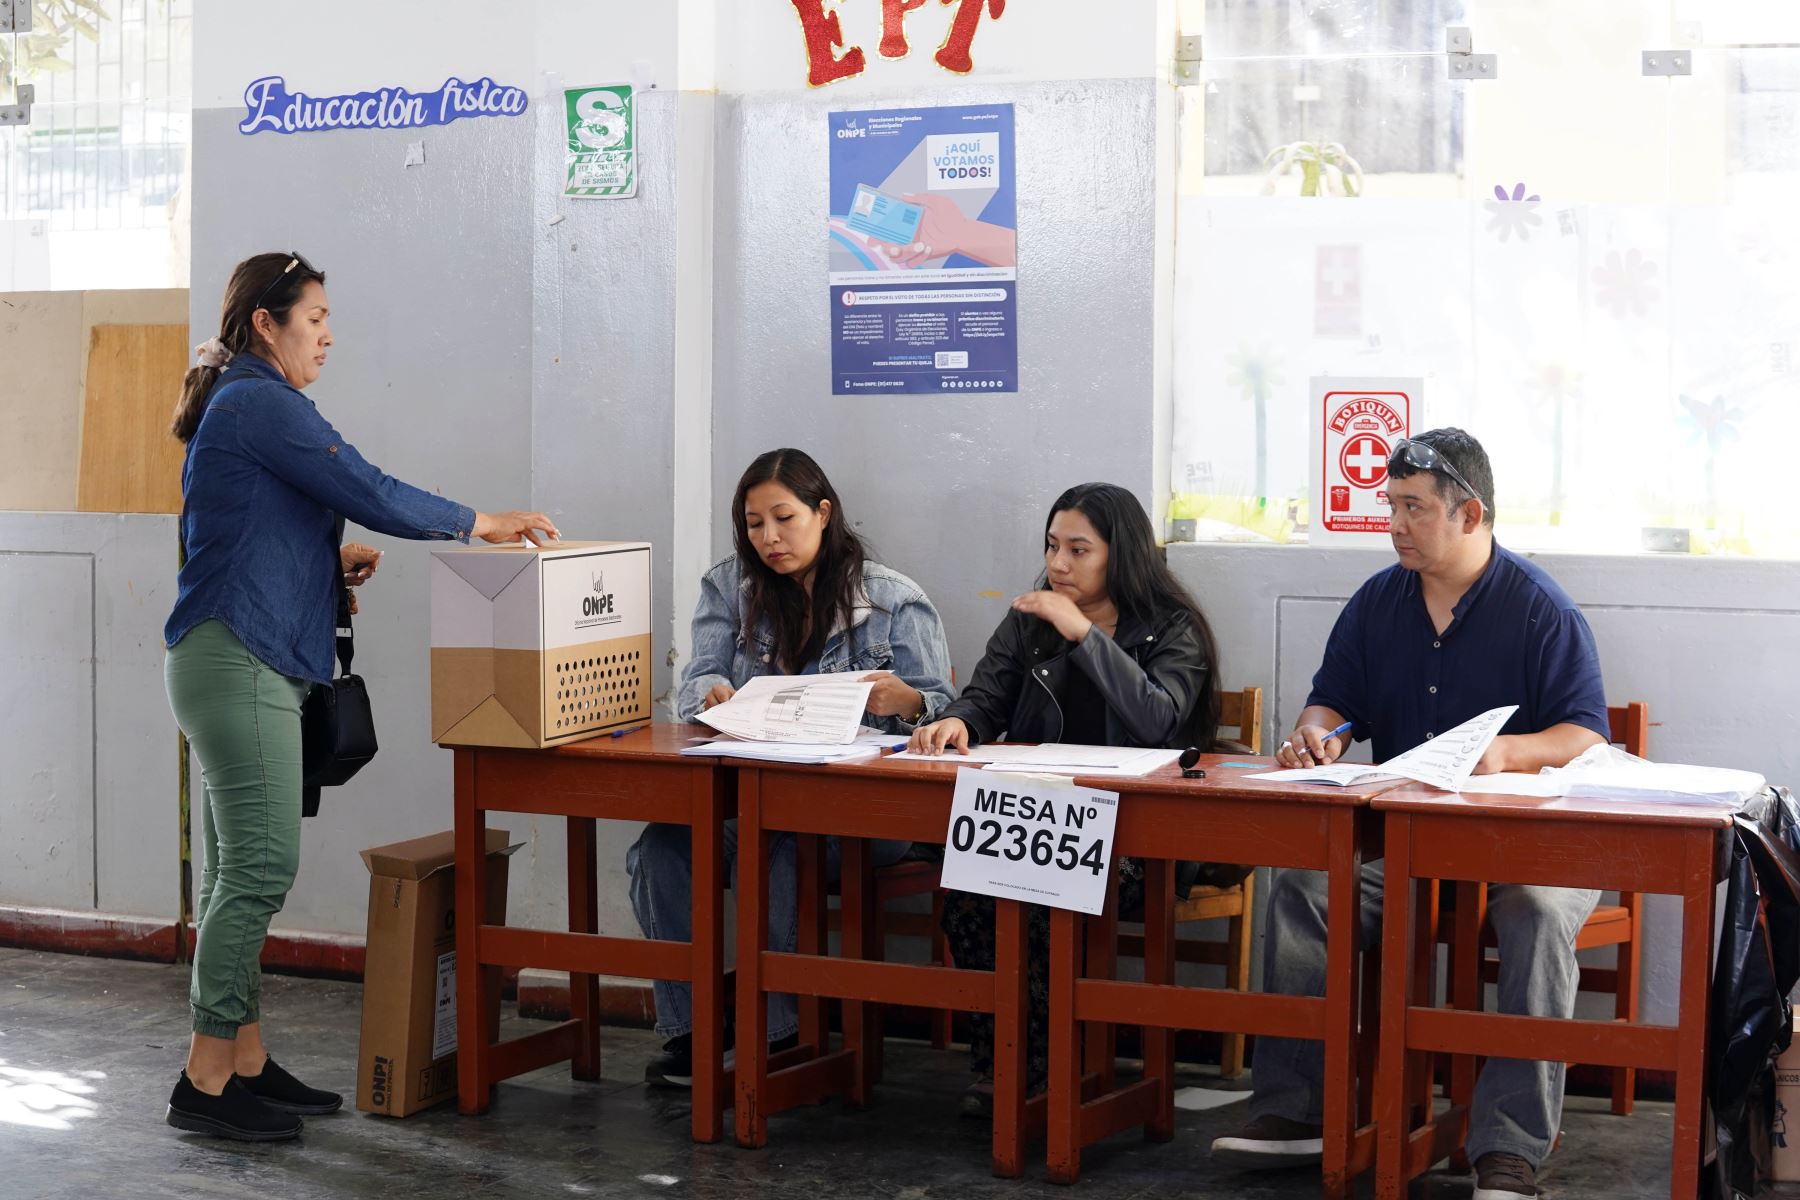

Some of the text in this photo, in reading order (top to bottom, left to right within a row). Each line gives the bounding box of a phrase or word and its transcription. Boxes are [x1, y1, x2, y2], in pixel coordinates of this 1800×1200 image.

[241, 77, 428, 133] Educación
[575, 90, 626, 149] S
[836, 128, 866, 138] ONPE
[933, 155, 994, 166] VOTAMOS
[946, 140, 981, 155] ¡AQUÍ
[939, 167, 991, 179] TODOS!
[1335, 400, 1399, 430] BOTIQUIN
[583, 594, 613, 616] ONPE
[974, 788, 1056, 824] MESA
[952, 815, 1104, 876] 023654
